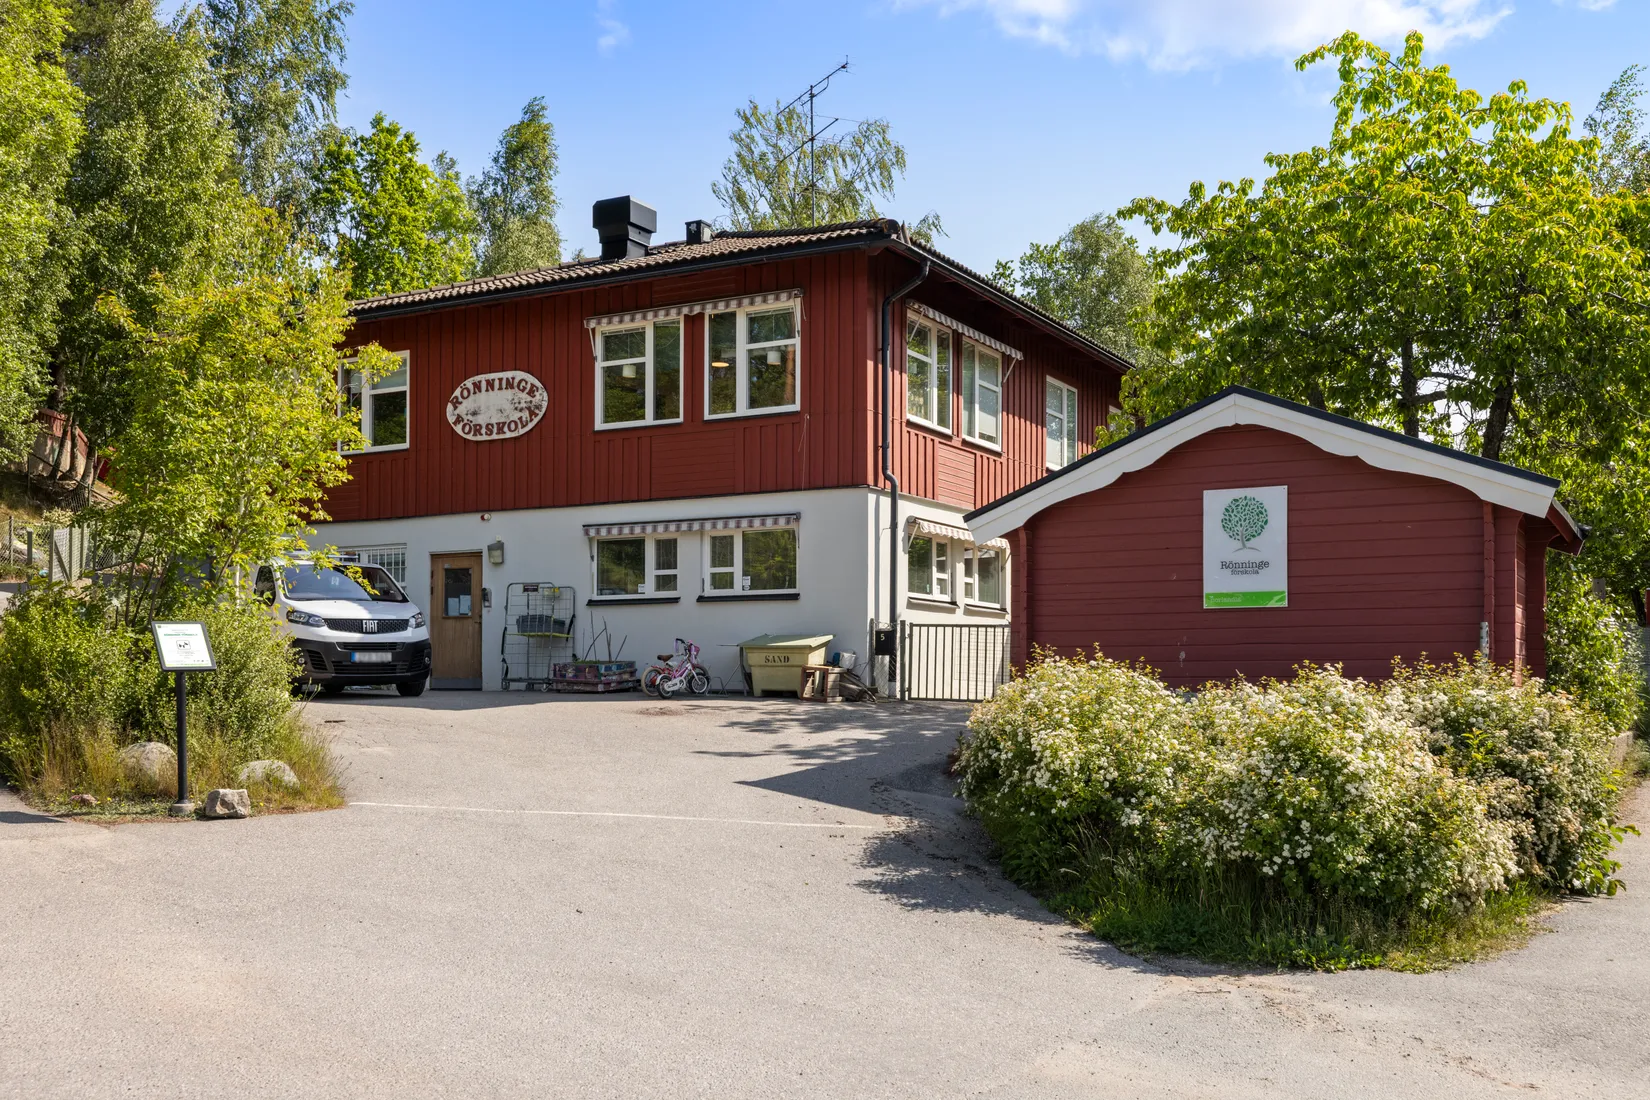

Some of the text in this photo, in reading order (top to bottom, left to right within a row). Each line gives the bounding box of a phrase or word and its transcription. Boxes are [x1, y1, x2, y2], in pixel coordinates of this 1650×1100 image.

[448, 377, 539, 411] RÖNNINGE
[452, 406, 539, 437] FÖRSKOLA
[1220, 560, 1270, 570] Rönninge
[362, 619, 378, 632] FIAT
[880, 633, 885, 641] 5
[764, 655, 790, 664] SAND
